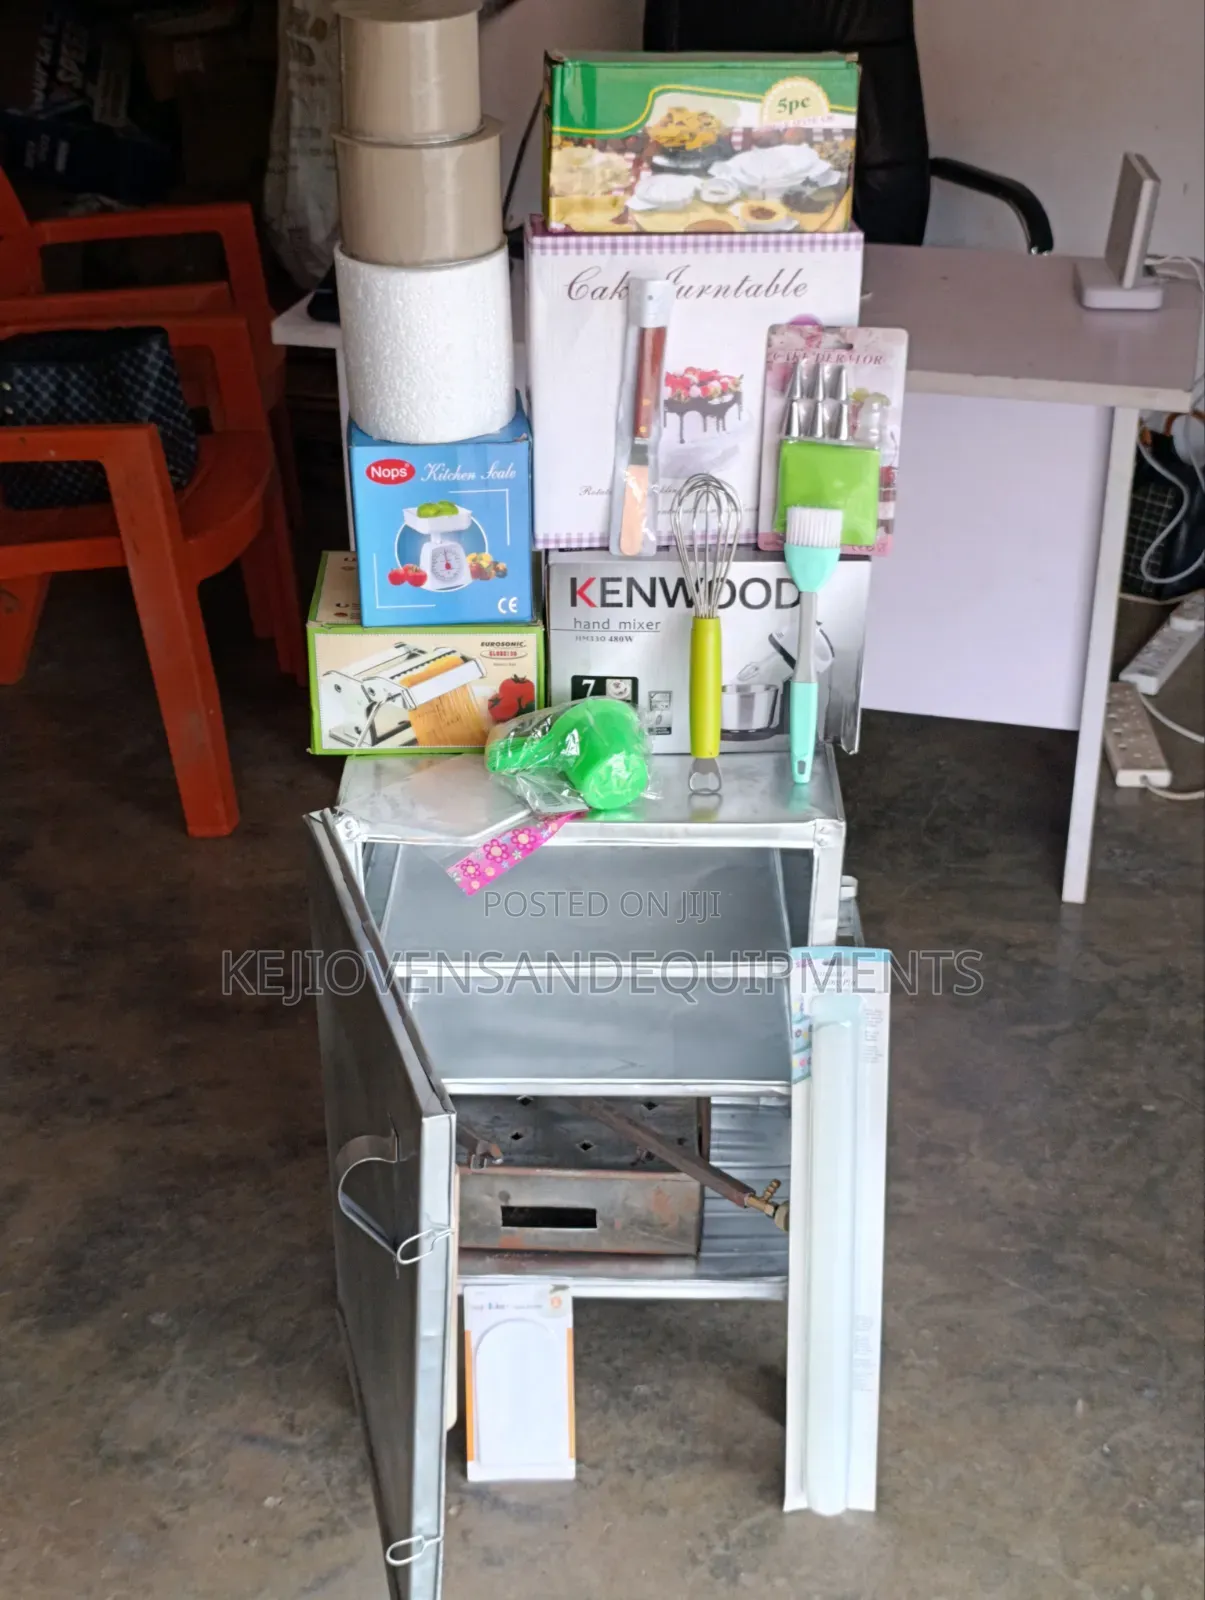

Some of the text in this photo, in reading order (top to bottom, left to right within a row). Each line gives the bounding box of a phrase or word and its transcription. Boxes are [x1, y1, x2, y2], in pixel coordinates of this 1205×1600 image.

[776, 96, 812, 115] 5pc
[565, 265, 632, 301] Cak
[370, 465, 408, 480] Nops
[420, 460, 517, 482] Kitchen Scale
[570, 576, 801, 610] KENWOOD
[573, 618, 662, 631] hand mixer
